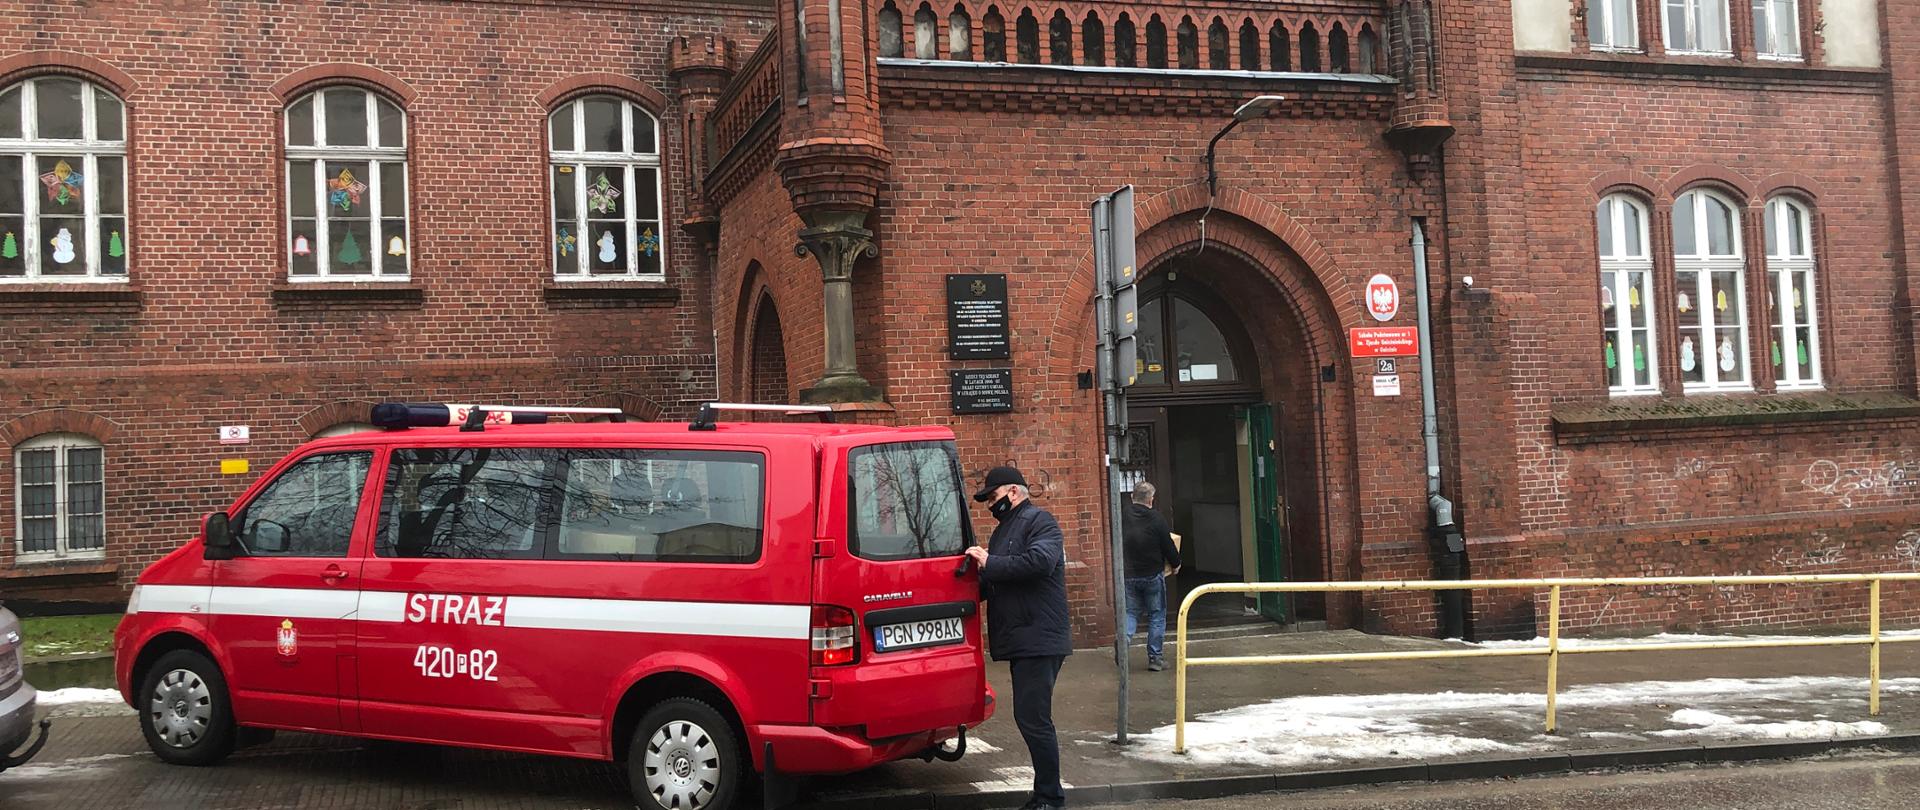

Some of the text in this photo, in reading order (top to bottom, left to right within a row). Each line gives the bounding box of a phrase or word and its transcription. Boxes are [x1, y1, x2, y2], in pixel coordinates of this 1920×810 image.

[1380, 360, 1393, 372] 2a
[458, 408, 506, 422] SAŻ
[863, 591, 913, 602] CARAVELLE
[408, 593, 504, 627] STRAŻ
[882, 618, 962, 646] PGN 998AK
